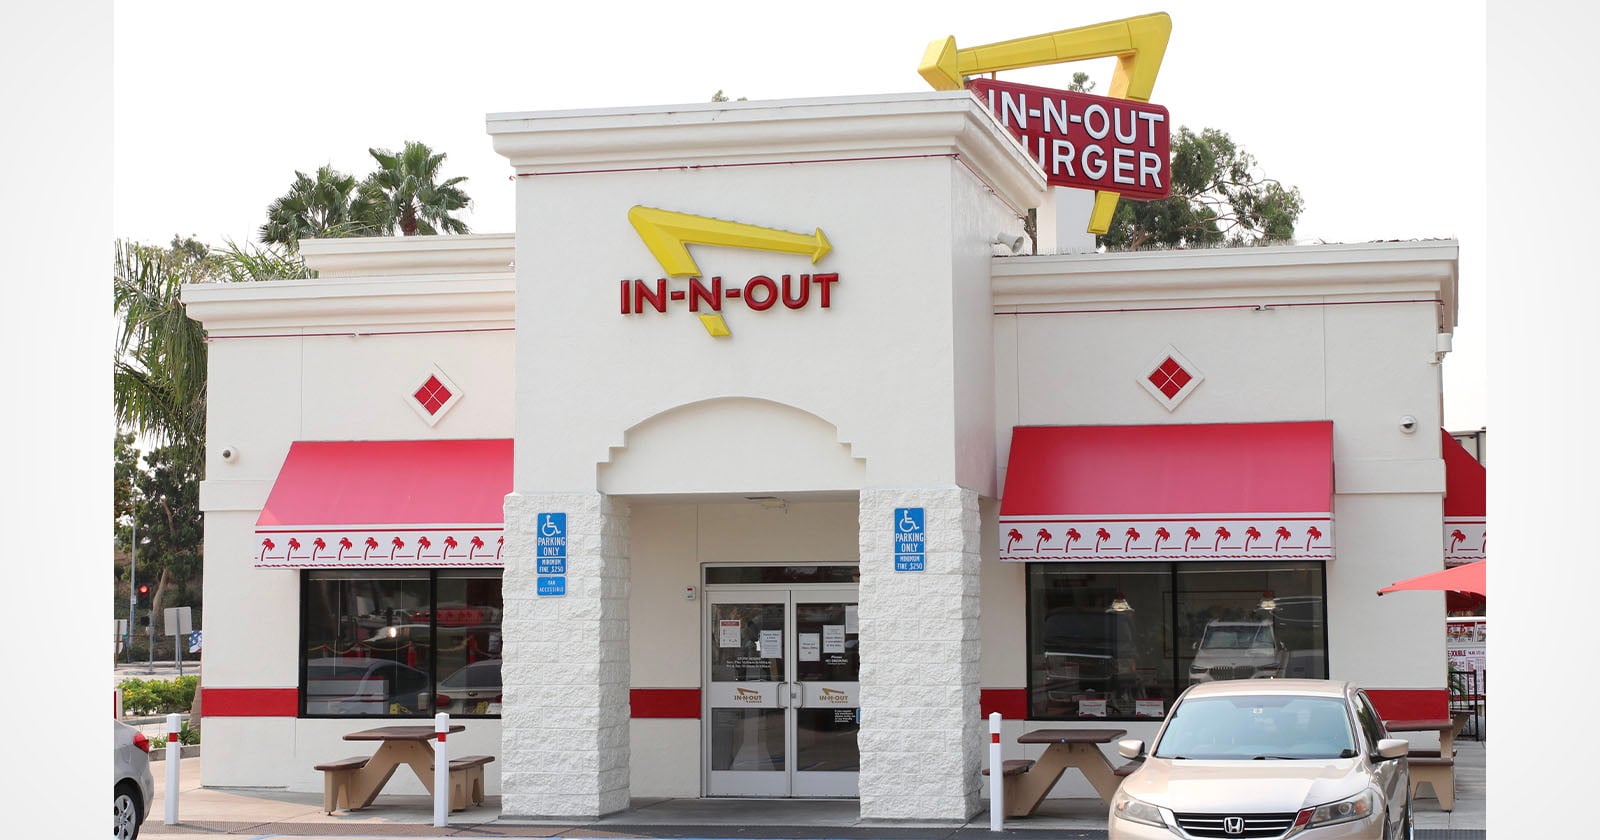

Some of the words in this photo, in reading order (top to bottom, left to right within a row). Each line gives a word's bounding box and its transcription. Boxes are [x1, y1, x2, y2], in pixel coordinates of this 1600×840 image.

[988, 88, 1165, 148] IN-N-OUT
[1021, 135, 1163, 189] URGER
[620, 273, 839, 314] IN-N-OUT
[537, 537, 566, 546] PARKING
[895, 532, 924, 542] PARKING
[543, 547, 560, 556] ONLY
[901, 543, 918, 553] ONLY
